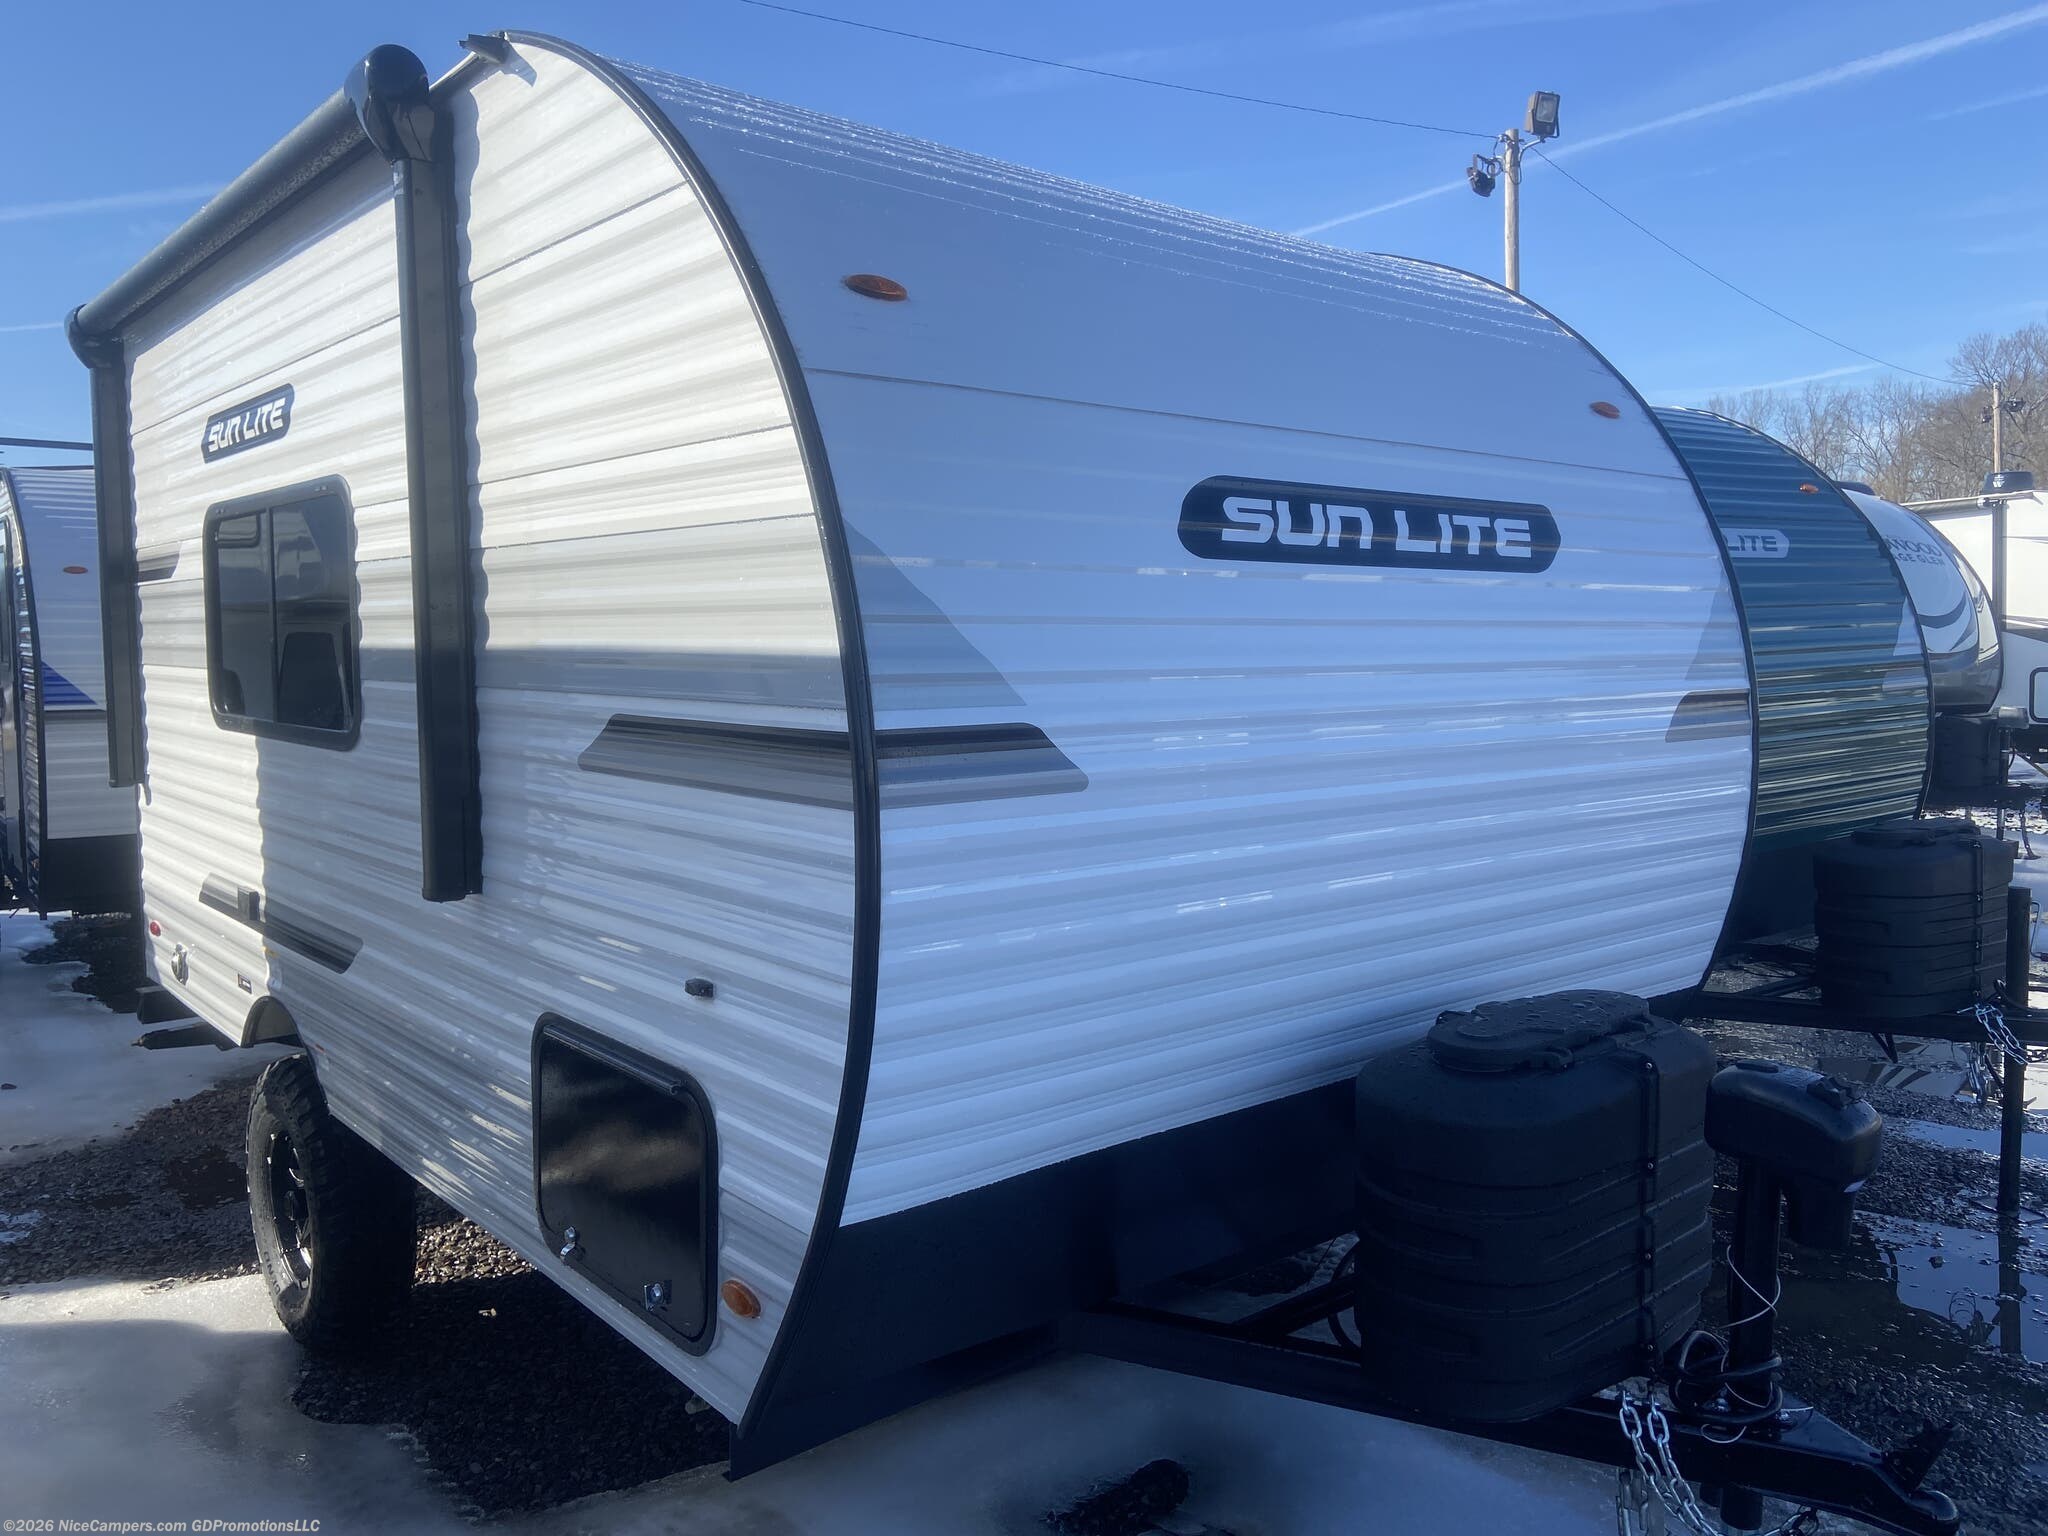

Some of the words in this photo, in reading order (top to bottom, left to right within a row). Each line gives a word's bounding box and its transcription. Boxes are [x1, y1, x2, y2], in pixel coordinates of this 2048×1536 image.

[208, 415, 241, 453] SUN
[243, 398, 286, 440] LITE
[1221, 496, 1374, 550] SUN
[1394, 510, 1532, 558] LITE
[1723, 534, 1778, 552] LITE
[1886, 537, 1942, 557] WOOD
